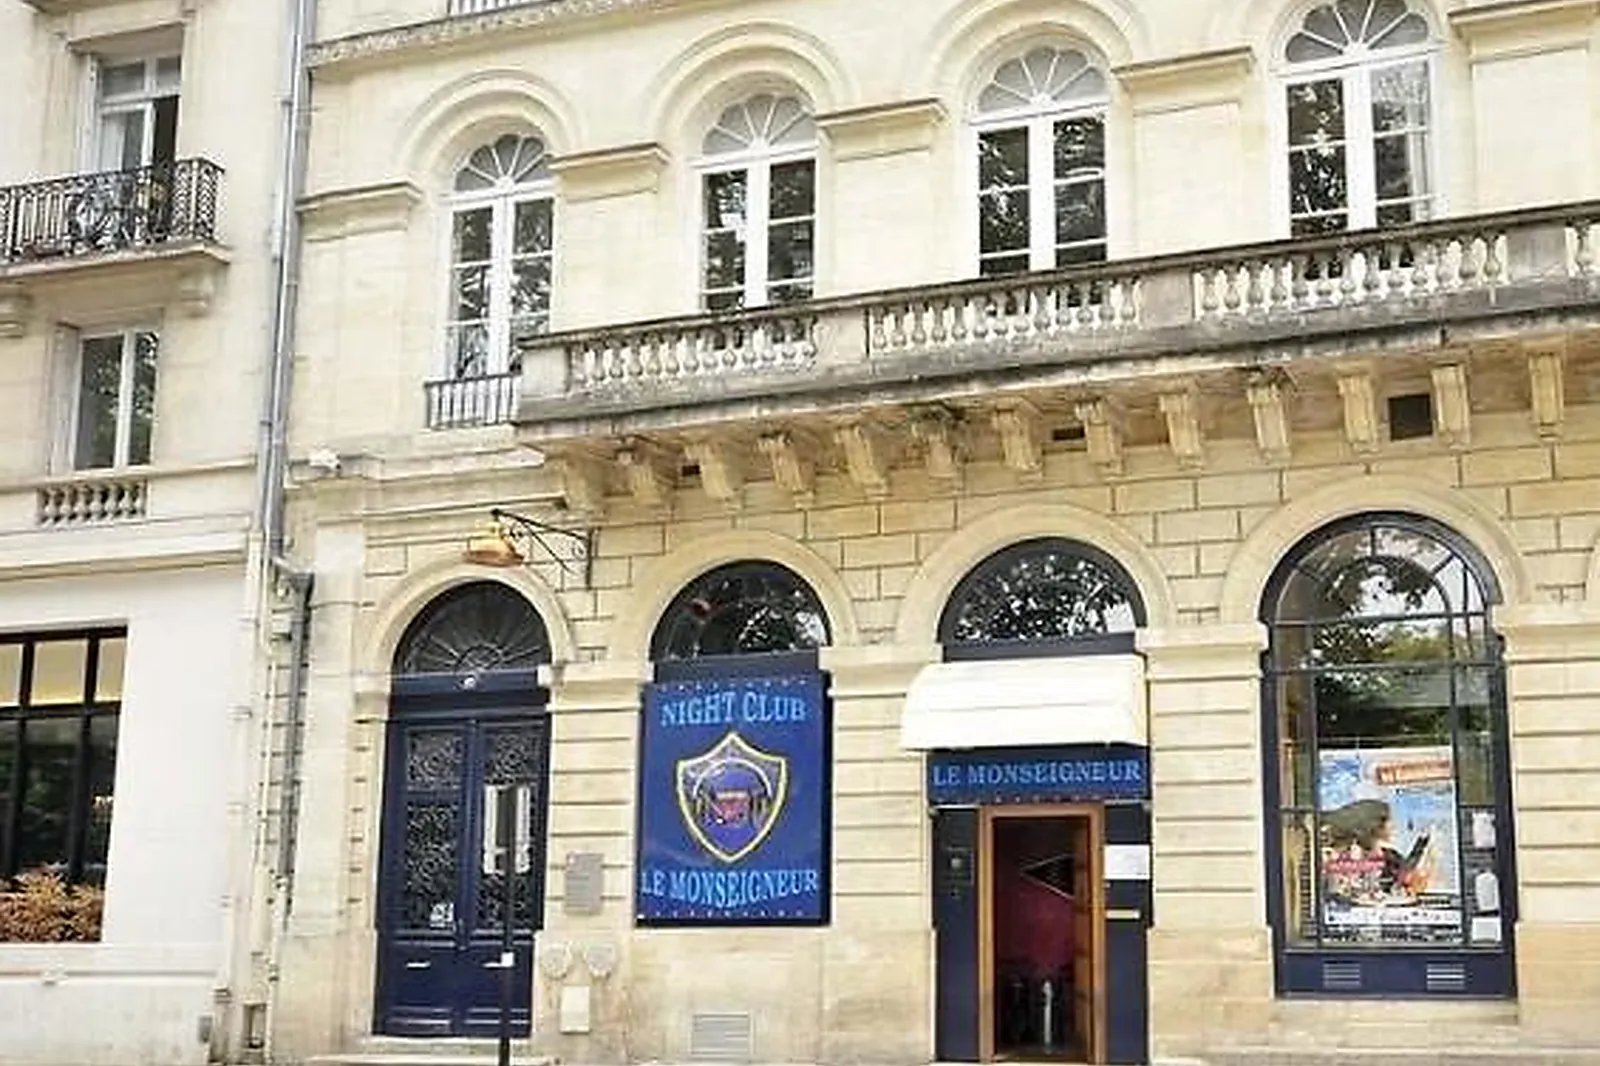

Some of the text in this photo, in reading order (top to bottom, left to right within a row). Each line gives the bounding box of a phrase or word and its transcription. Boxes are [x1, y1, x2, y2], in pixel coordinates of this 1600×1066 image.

[661, 691, 806, 727] NIGHT CLUB
[933, 760, 1141, 786] LE MONSEIGNEUR
[641, 870, 665, 896] LE
[669, 869, 817, 908] MONSEIGNEUR
